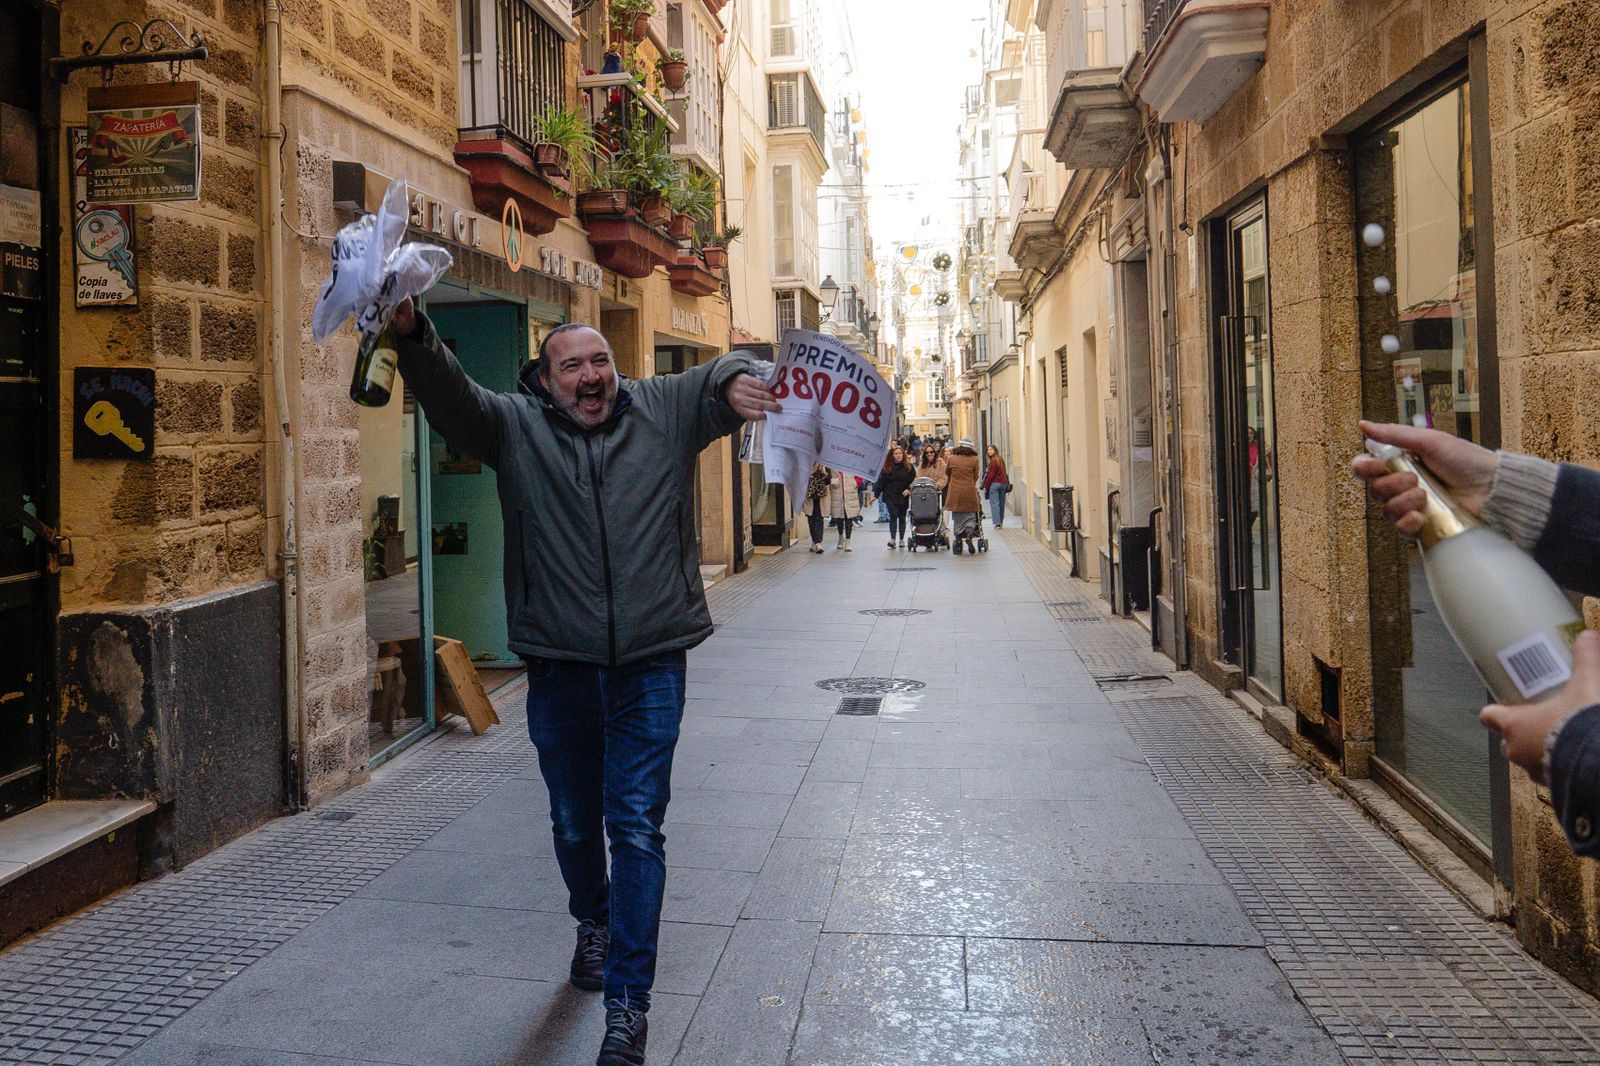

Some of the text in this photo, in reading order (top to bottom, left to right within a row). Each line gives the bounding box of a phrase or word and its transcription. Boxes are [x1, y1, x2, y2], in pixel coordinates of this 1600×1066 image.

[113, 120, 167, 133] ZAPATERÍA
[94, 178, 131, 187] LLAVES
[148, 184, 193, 194] ZAPATOS
[5, 252, 39, 271] PIELES
[79, 276, 108, 288] Copia
[79, 289, 123, 300] de llaves
[794, 344, 878, 394] PREMIO
[769, 365, 882, 430] 88008
